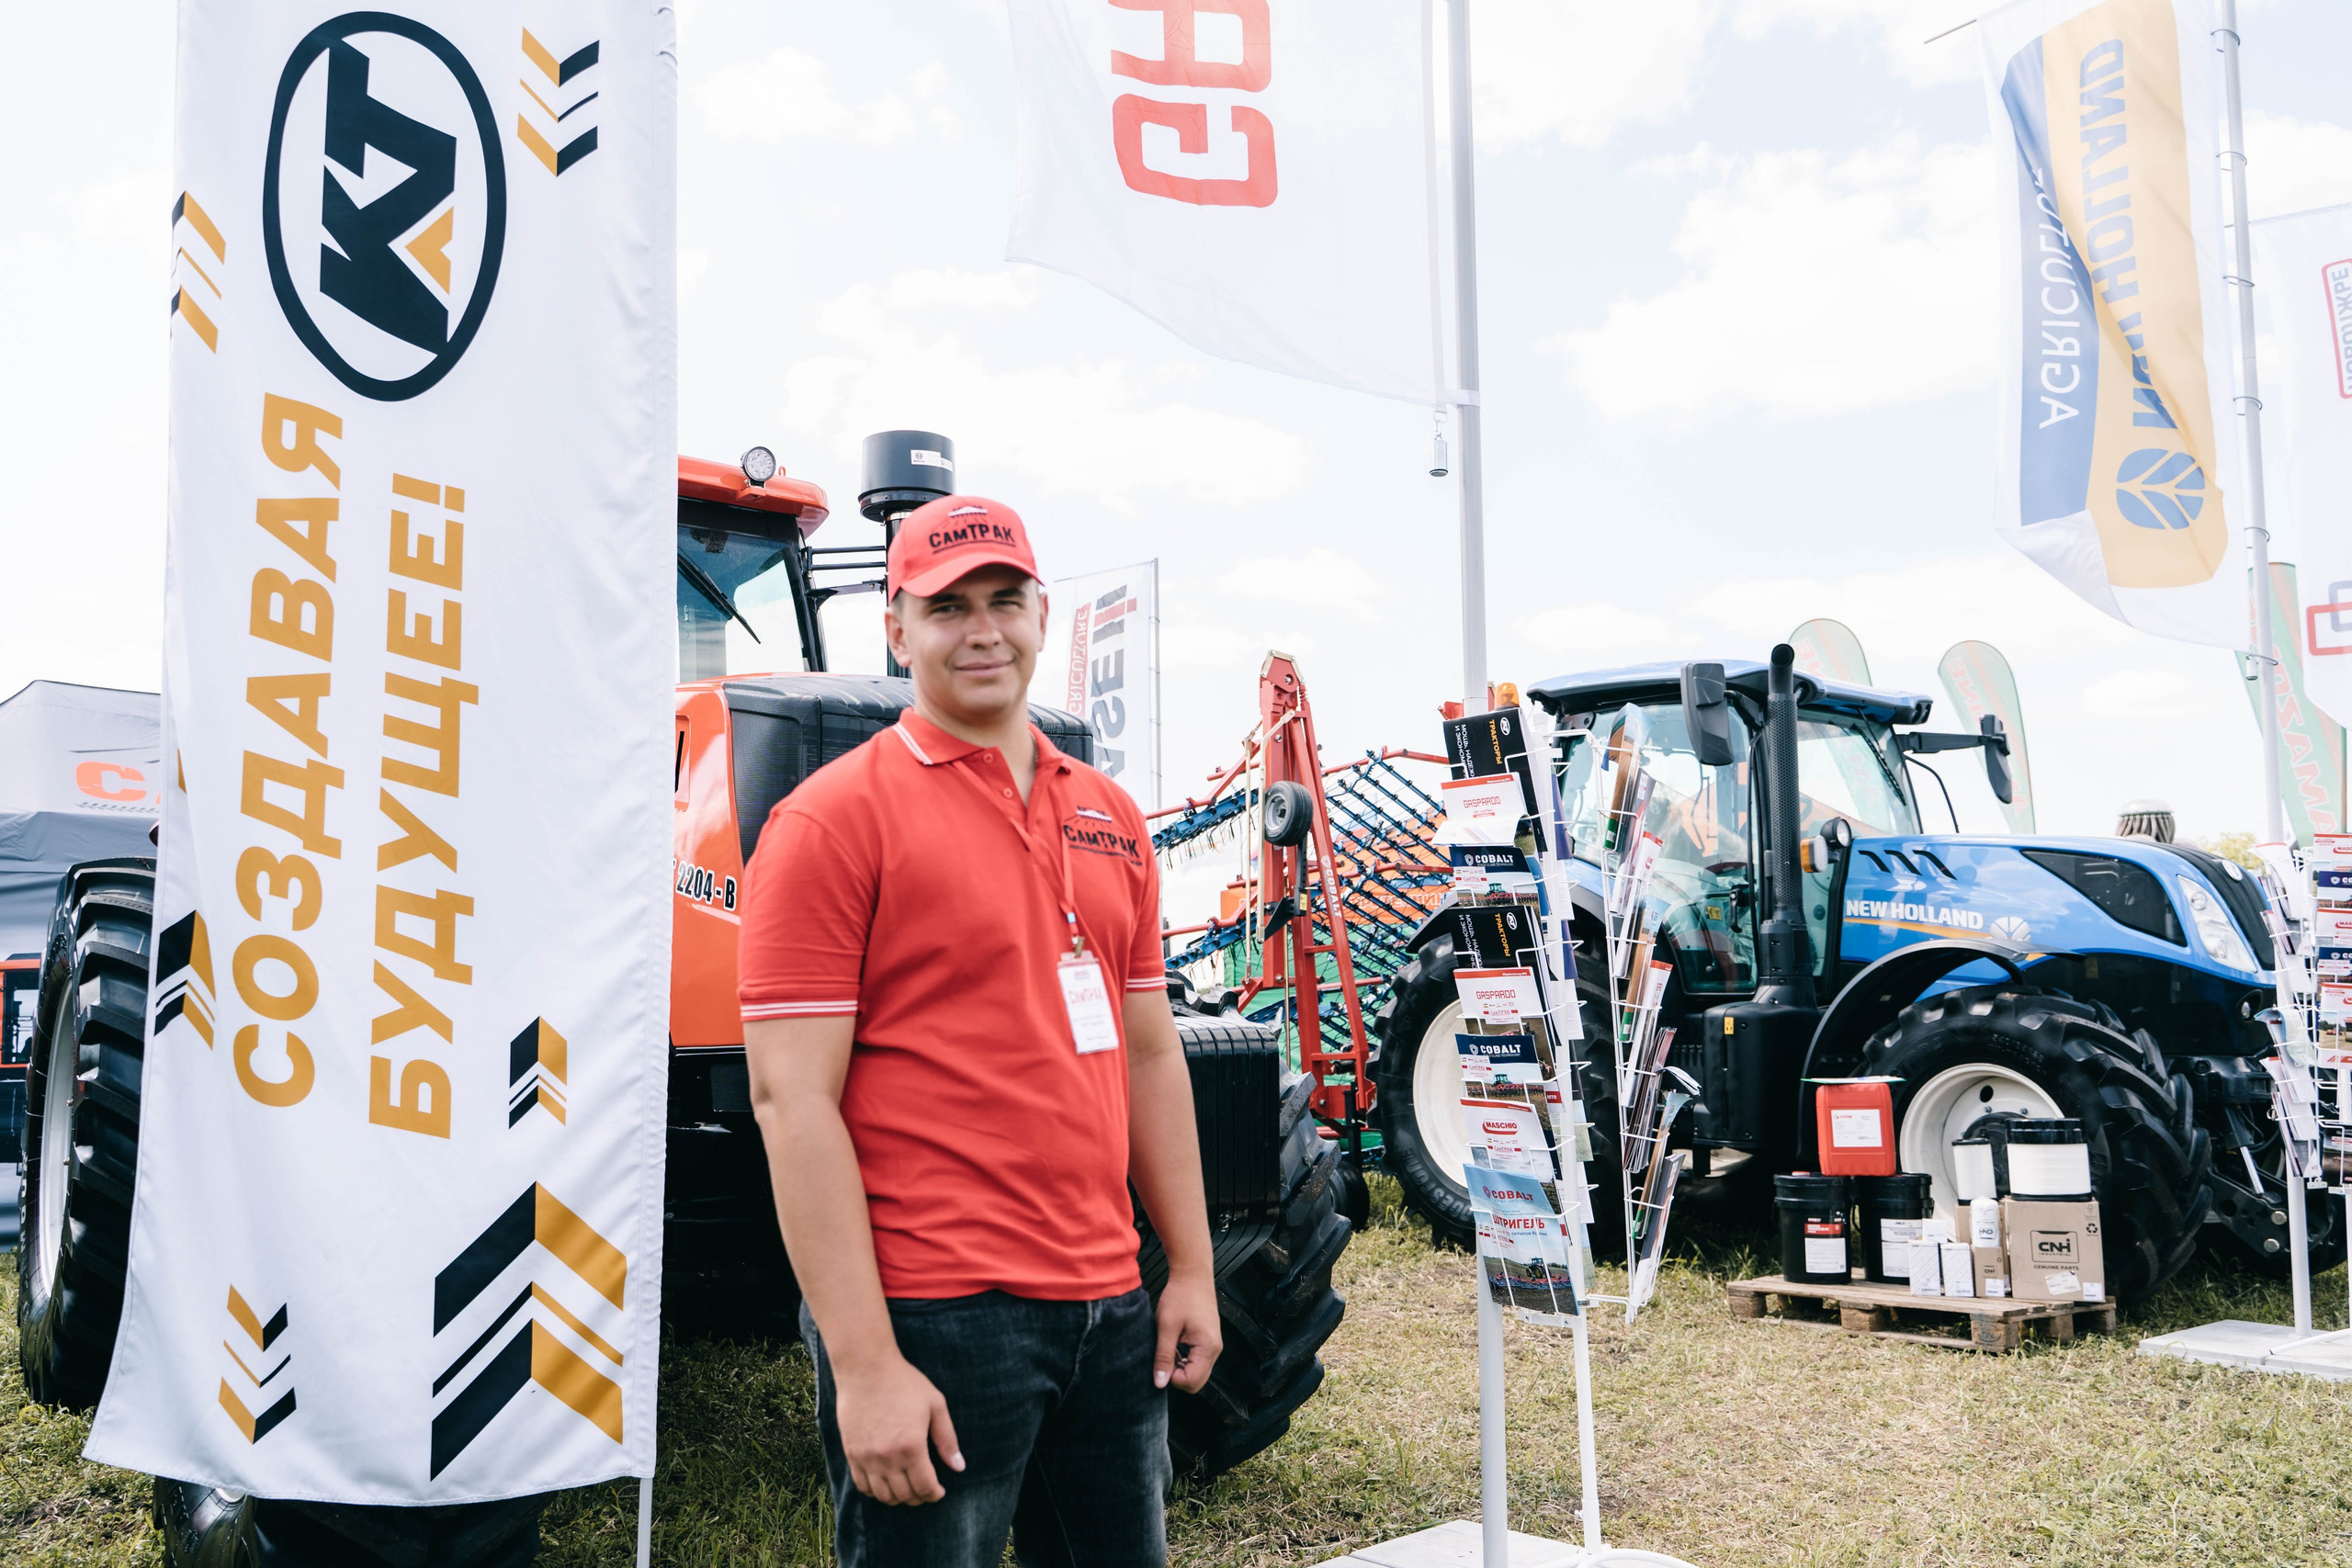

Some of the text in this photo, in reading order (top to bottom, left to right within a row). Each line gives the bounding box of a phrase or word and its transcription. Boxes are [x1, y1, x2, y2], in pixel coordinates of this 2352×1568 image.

[232, 391, 345, 1108] СОЗДАВАЯ
[1488, 719, 1503, 765] ТРАКТОРЫ
[368, 471, 480, 1139] БУДУЩЕЕ!
[1463, 795, 1501, 808] GASPARDO
[1475, 853, 1514, 863] COBALT
[1326, 869, 1342, 918] COBALT
[1846, 900, 1984, 931] NEW HOLLAND
[1494, 913, 1511, 957] ТРАКТОРЫ
[1476, 989, 1516, 999] GASPARDO
[1480, 1043, 1521, 1054] COBALT
[1485, 1121, 1518, 1130] MASCHIO
[1491, 1190, 1534, 1201] COBALT
[1492, 1214, 1545, 1229] ШТРИГЕЛЬ
